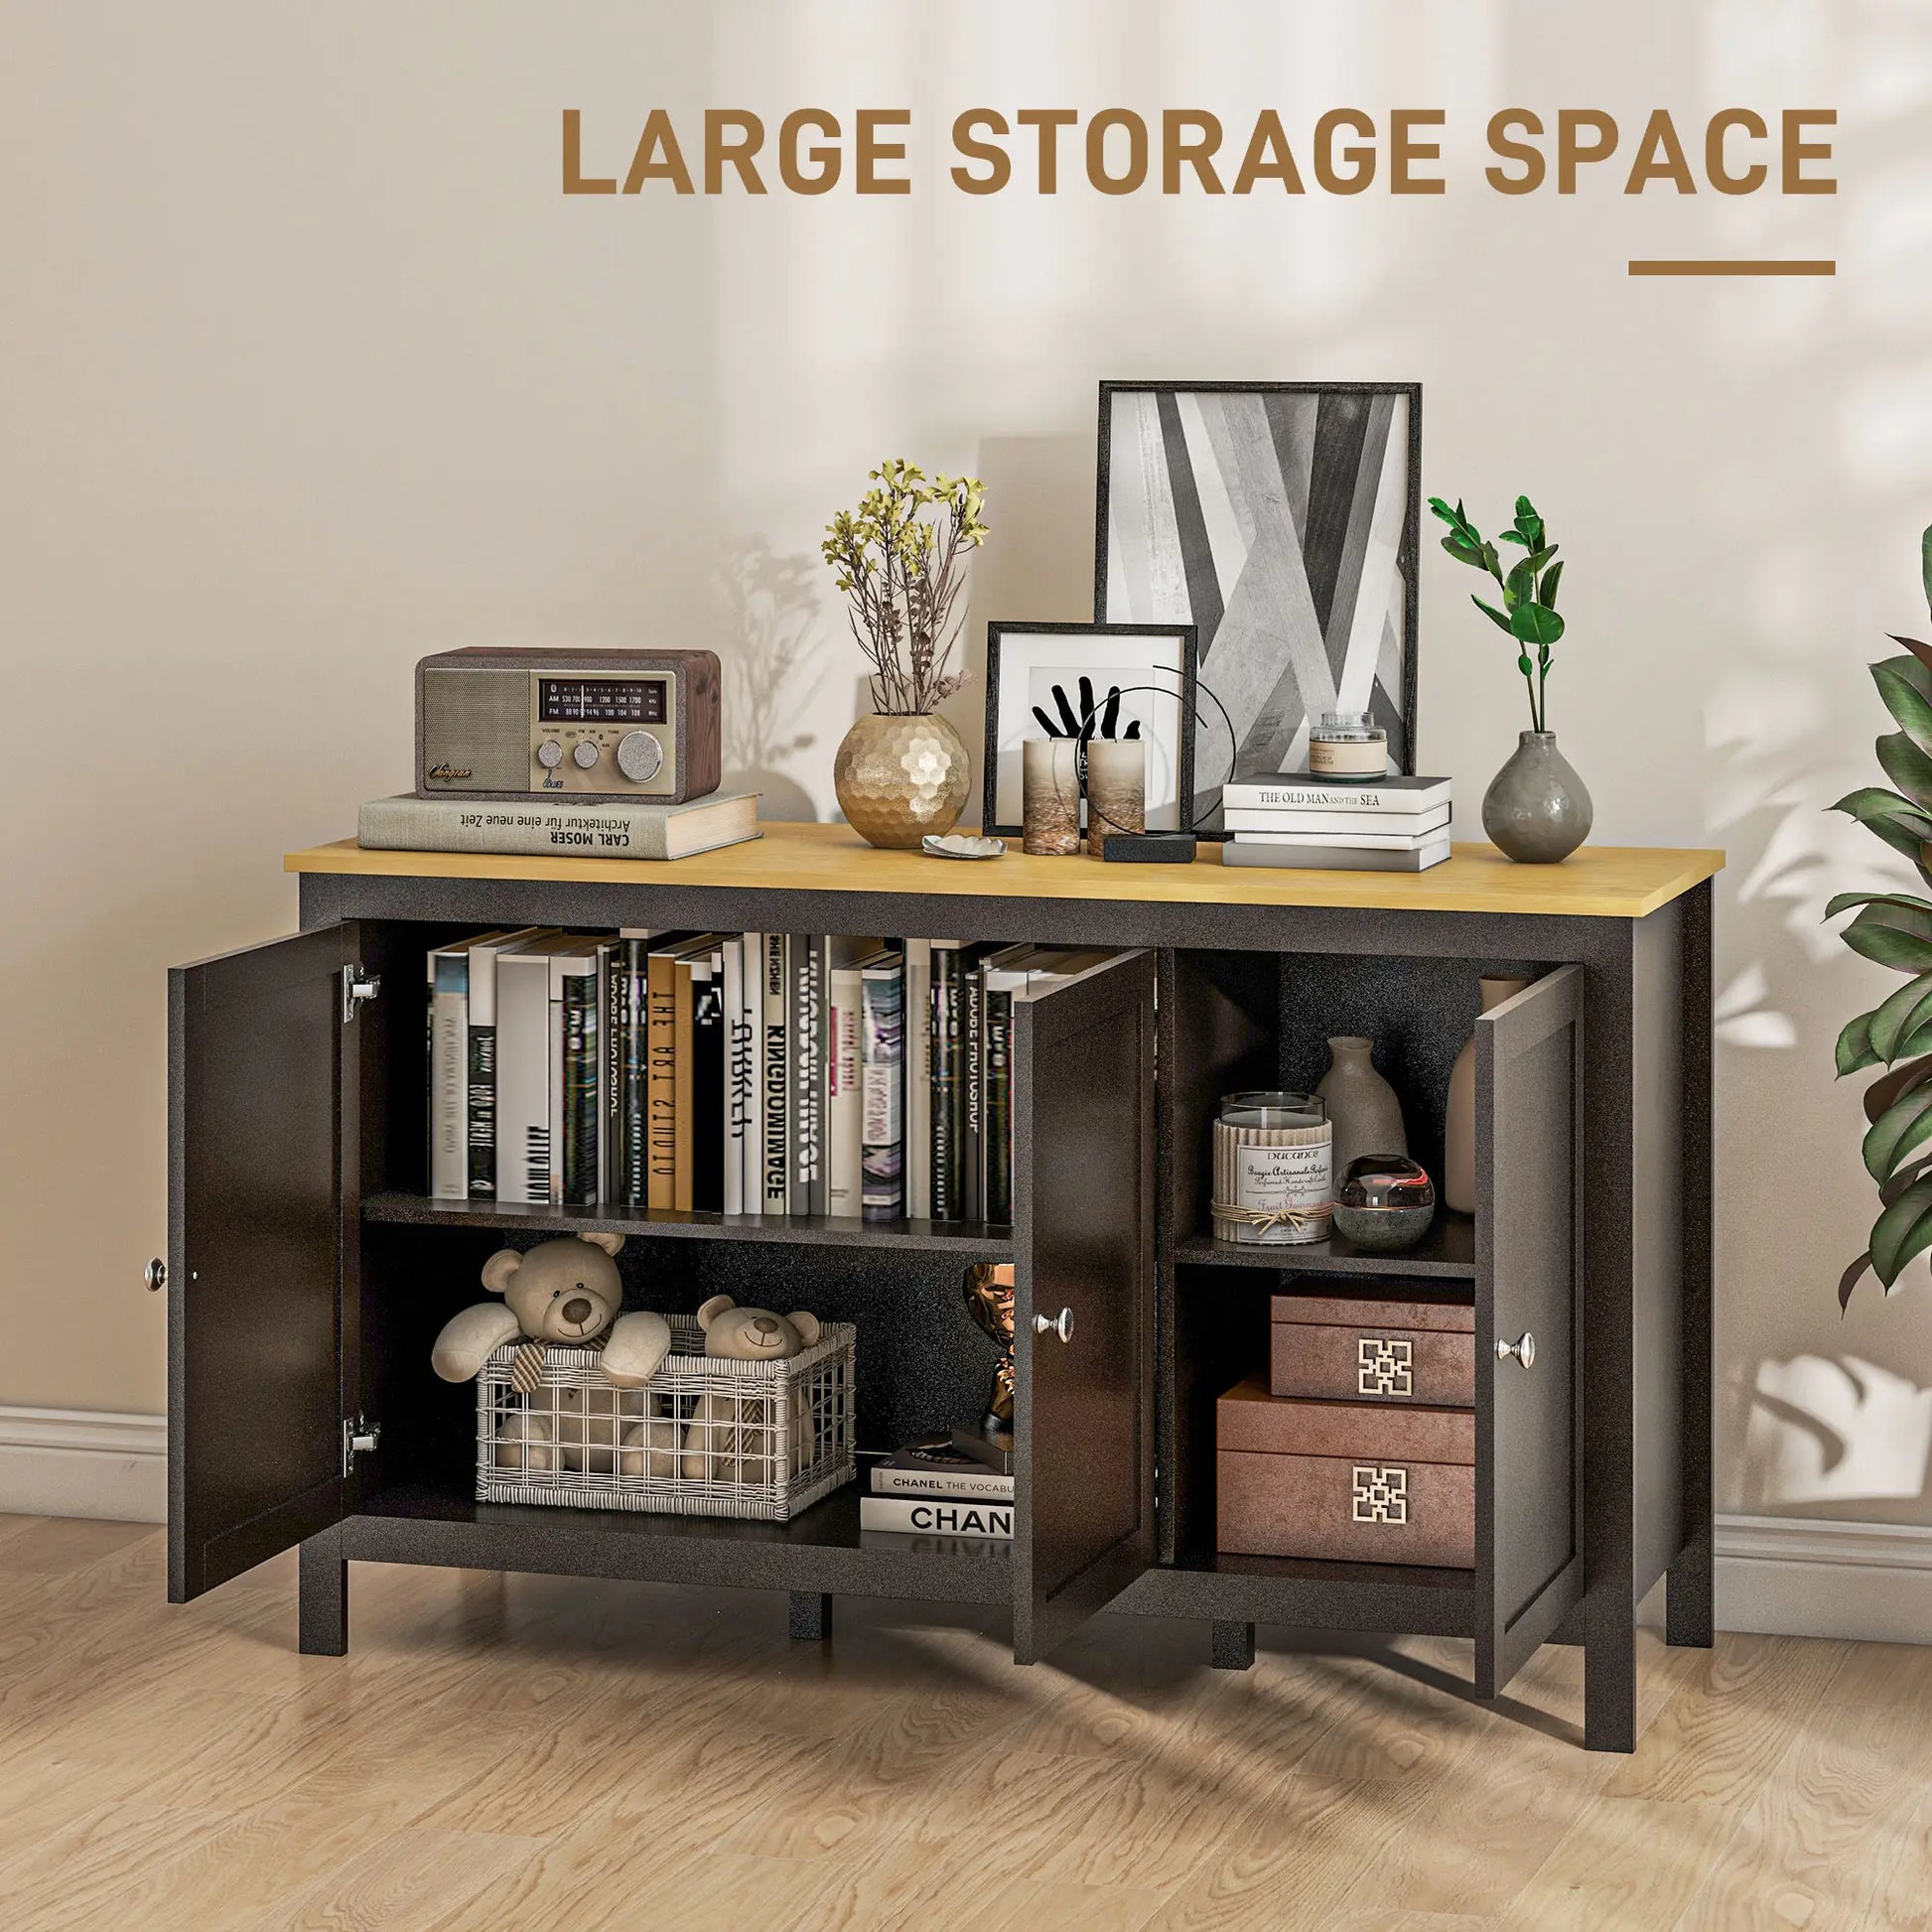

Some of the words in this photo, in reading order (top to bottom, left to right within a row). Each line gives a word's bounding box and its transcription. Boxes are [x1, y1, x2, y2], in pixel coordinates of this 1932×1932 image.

[1259, 792, 1281, 803] THE
[1282, 792, 1305, 803] OLD
[1307, 793, 1328, 804] MAN
[1360, 794, 1380, 806] SEA
[461, 814, 483, 827] Zeit
[486, 815, 513, 825] neue
[518, 816, 542, 829] eine
[546, 817, 562, 830] für
[566, 817, 630, 833] Architektur
[550, 831, 593, 845] MOSER
[598, 832, 629, 846] CARL
[894, 1477, 943, 1489] CHANEL
[947, 1481, 967, 1491] THE
[969, 1483, 1015, 1493] VOCABU
[910, 1507, 1011, 1535] CHAN
